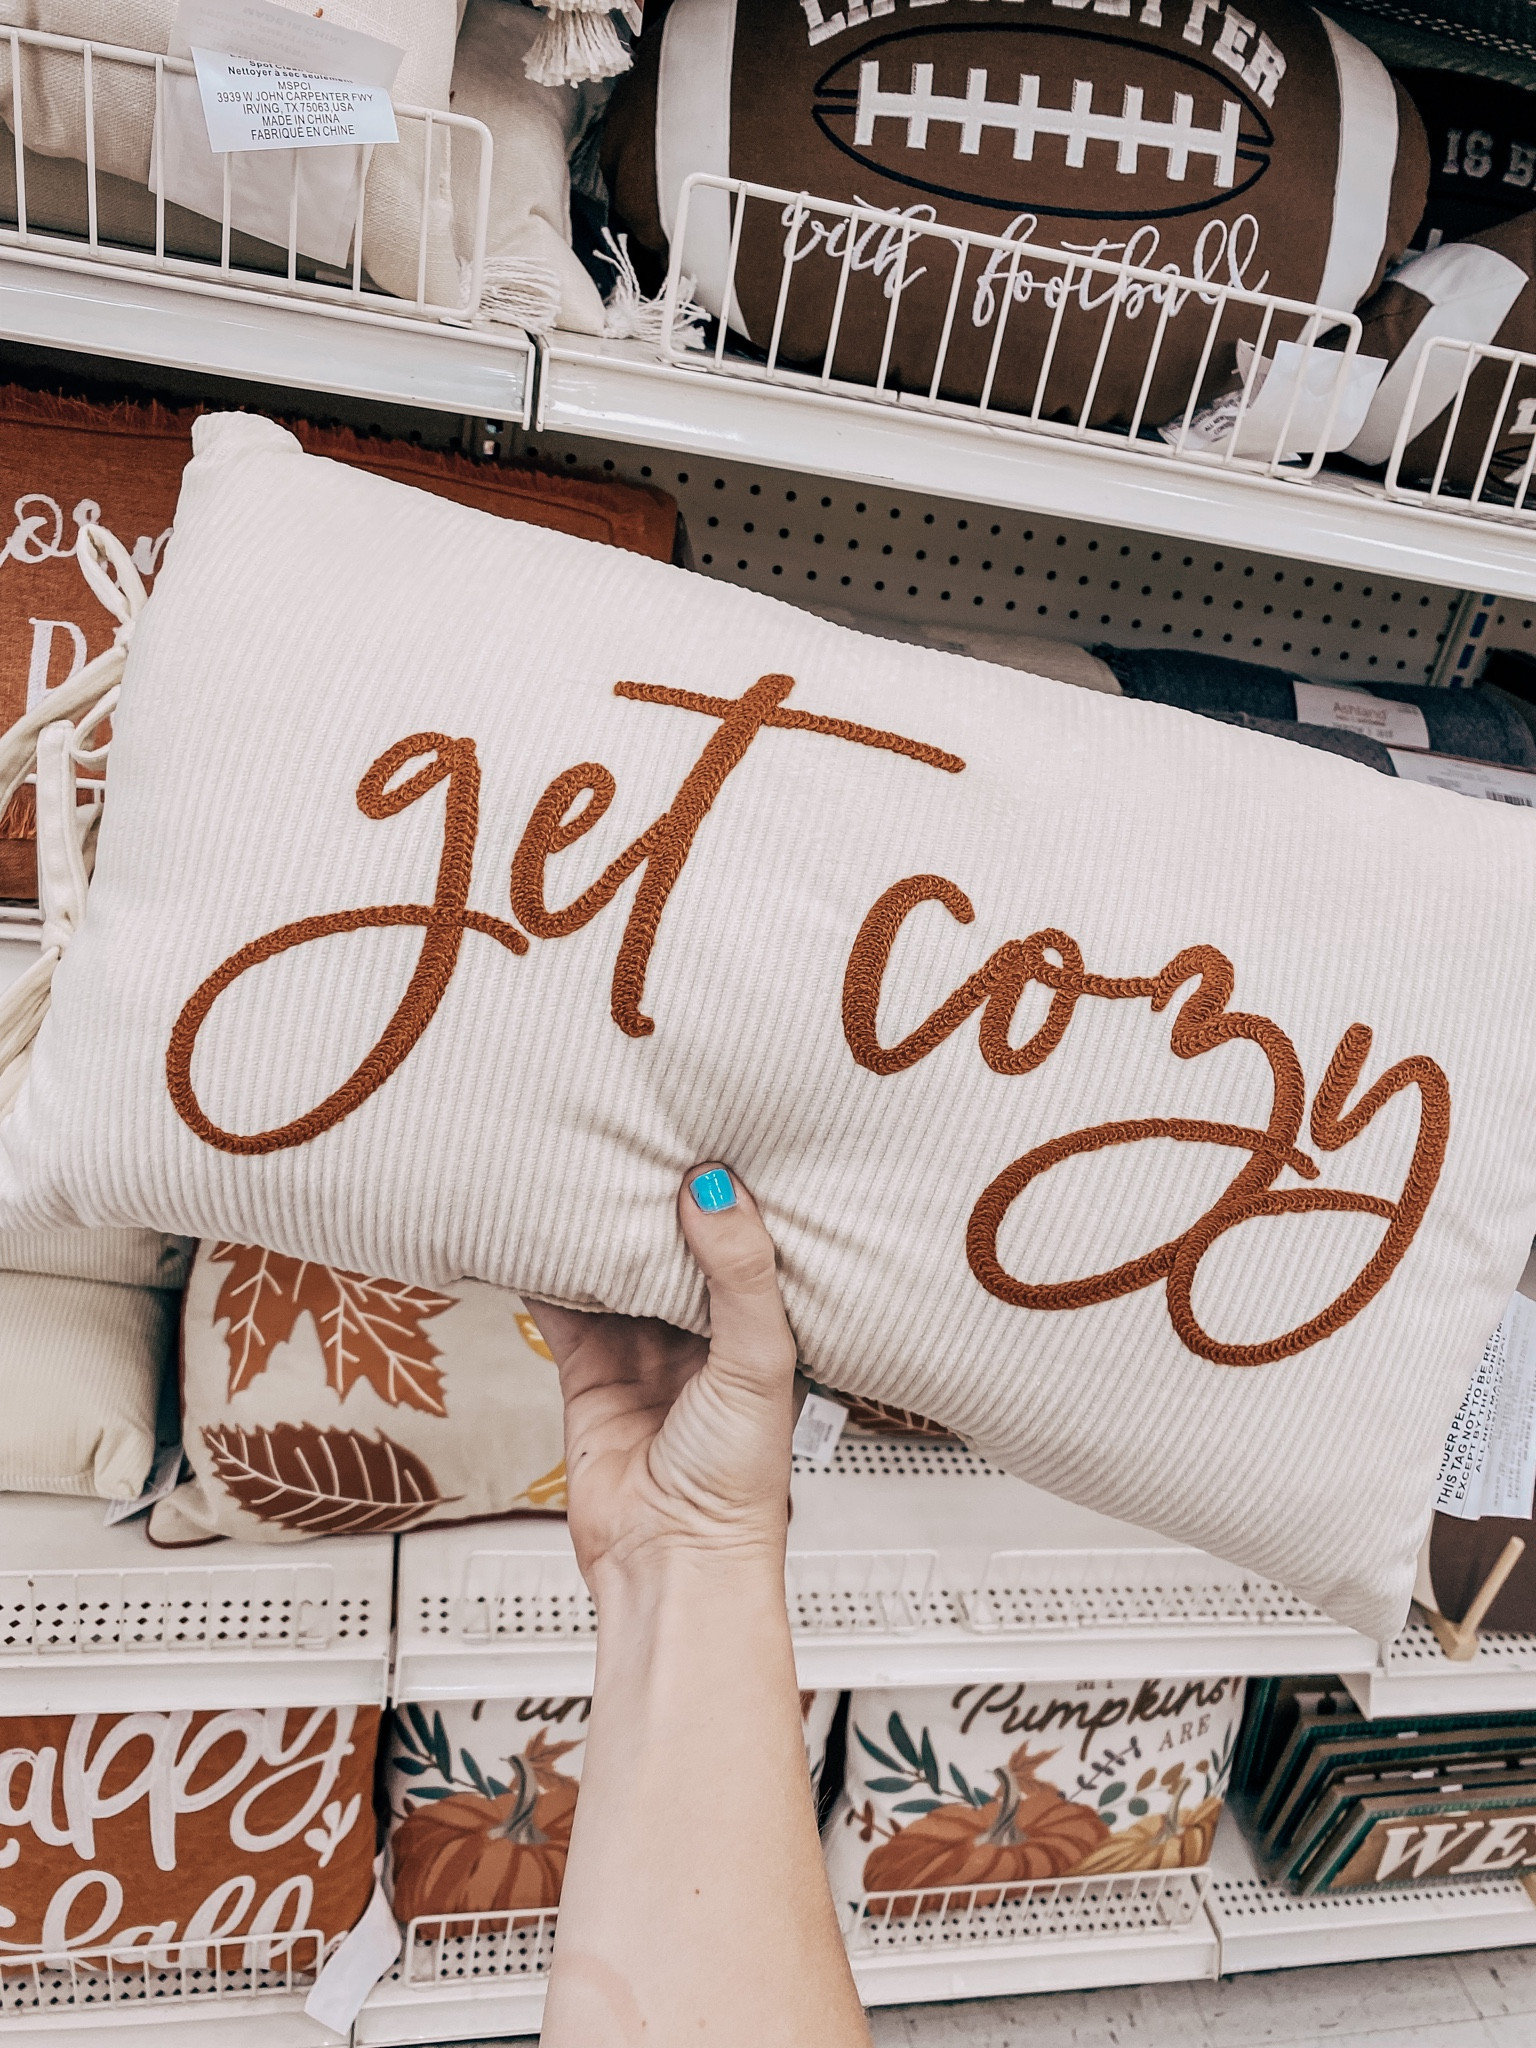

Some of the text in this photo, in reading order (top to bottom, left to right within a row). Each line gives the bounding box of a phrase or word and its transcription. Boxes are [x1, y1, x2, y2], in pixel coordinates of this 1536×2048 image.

[228, 66, 271, 77] Nettoyer
[275, 69, 280, 77] à
[217, 91, 373, 103] 3939 W JOHN CARPENTER FWY
[278, 81, 311, 91] MSPCI
[243, 103, 284, 115] IRVING,
[284, 103, 299, 113] TX
[262, 113, 340, 126] MADE IN CHINA
[306, 126, 320, 137] EN
[322, 124, 355, 137] CHINE
[971, 213, 1269, 328] football
[165, 673, 1452, 1367] get cozy
[1476, 1364, 1488, 1385] BE
[1471, 1387, 1482, 1407] TO
[1461, 1410, 1477, 1441] NOT
[1455, 1442, 1476, 1500] EXCEPT
[1472, 1420, 1482, 1440] BY
[1479, 1388, 1490, 1416] THE
[1450, 1443, 1468, 1471] TAG
[1475, 1448, 1485, 1473] ALL
[1436, 1473, 1457, 1505] THIS
[952, 1677, 1227, 1762] Pumpkins
[1157, 1713, 1211, 1752] ARE
